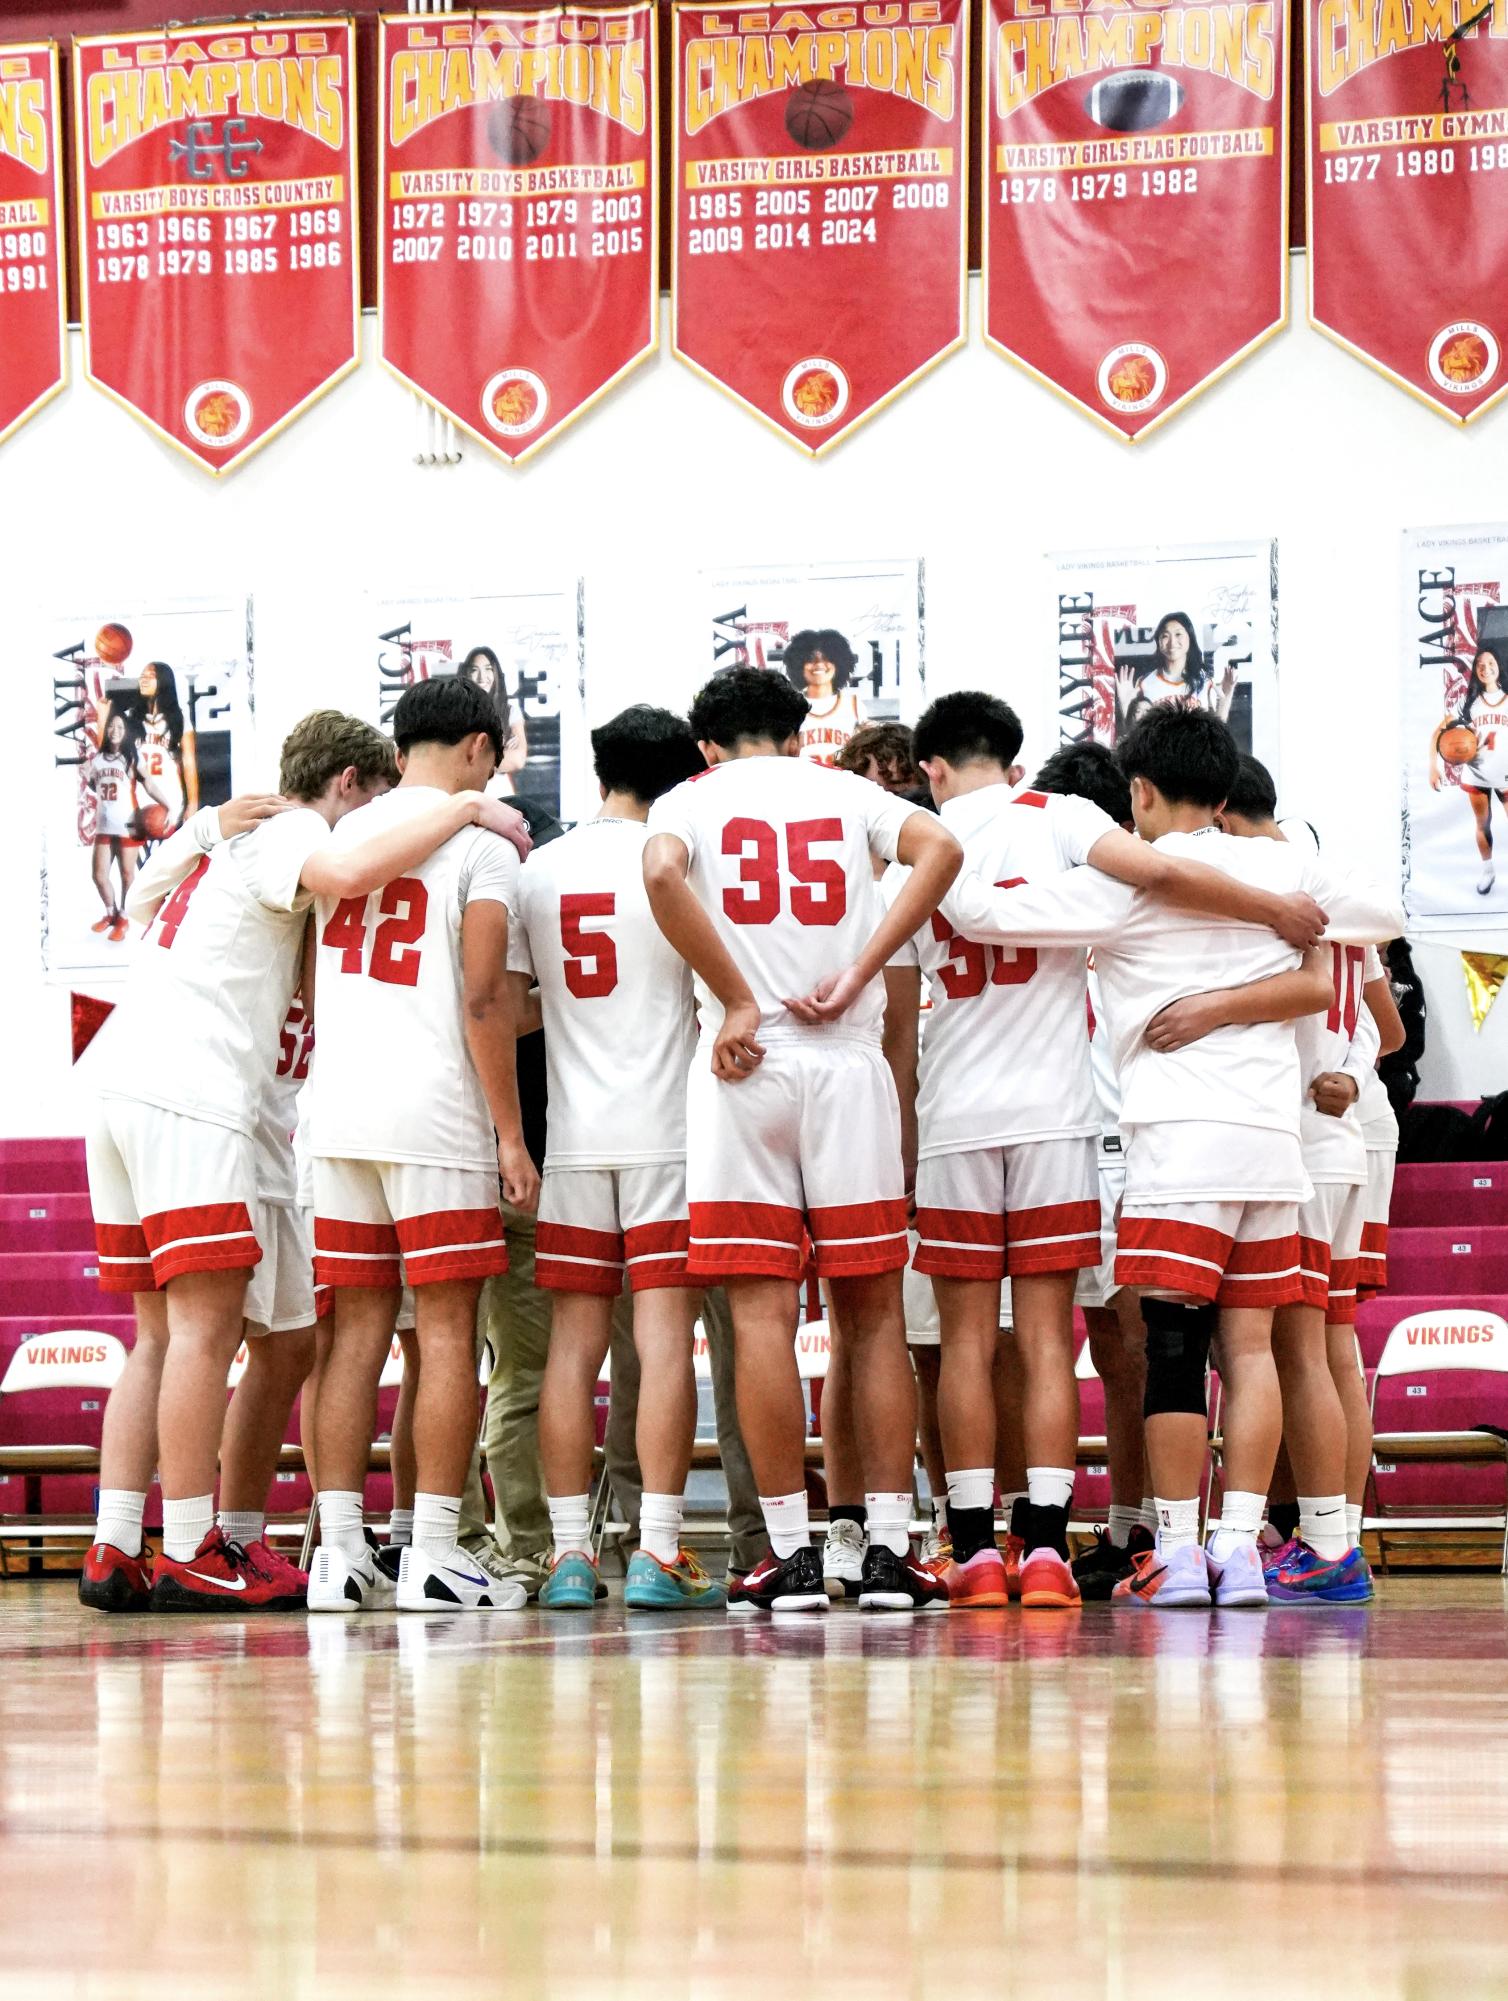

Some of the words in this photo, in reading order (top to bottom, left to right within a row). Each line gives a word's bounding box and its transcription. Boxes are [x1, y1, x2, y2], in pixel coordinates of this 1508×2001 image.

[408, 21, 636, 47] LEAGUE
[703, 3, 941, 34] LEAGUE
[103, 33, 328, 68] LEAGUE
[997, 2, 1275, 119] CHAMPIONS
[390, 40, 645, 147] CHAMPIONS
[685, 23, 954, 136] CHAMPIONS
[88, 54, 343, 168] CHAMPIONS
[1337, 117, 1434, 147] VARSITY
[1442, 112, 1508, 138] GYMN
[698, 161, 769, 184] VARSITY
[775, 158, 825, 181] GIRLS
[828, 151, 941, 179] BASKETBALL
[1006, 145, 1077, 169] VARSITY
[1082, 141, 1130, 165] GIRLS
[1133, 138, 1175, 161] FLAG
[1179, 131, 1264, 157] FOOTBALL
[1324, 153, 1381, 184] 1977
[1396, 148, 1454, 177] 1980
[102, 190, 165, 215] VARSITY
[169, 187, 209, 208] BOYS
[213, 184, 261, 206] CROSS
[264, 178, 334, 203] COUNTRY
[401, 171, 474, 194] VARSITY
[480, 168, 523, 192] BOYS
[527, 162, 634, 190] BASKETBALL
[1000, 177, 1057, 204] 1978
[1071, 173, 1127, 201] 1979
[1141, 168, 1198, 196] 1982
[393, 203, 444, 230] 1972
[457, 201, 513, 228] 1973
[526, 199, 578, 226] 1979
[591, 195, 642, 223] 2003
[688, 193, 742, 220] 1985
[755, 189, 810, 216] 2005
[824, 185, 878, 213] 2007
[892, 182, 949, 209] 2008
[96, 222, 149, 249] 1963
[157, 218, 211, 244] 1966
[224, 214, 277, 241] 1967
[289, 209, 341, 236] 1969
[392, 236, 443, 263] 2007
[457, 234, 512, 261] 2010
[525, 231, 577, 260] 2011
[591, 227, 642, 256] 2015
[688, 226, 742, 254] 2009
[755, 222, 810, 250] 2014
[821, 218, 877, 246] 2024
[97, 255, 149, 283] 1978
[157, 250, 211, 276] 1979
[224, 246, 278, 274] 1985
[289, 242, 341, 269] 1986
[1418, 566, 1455, 669] JACE
[53, 640, 86, 768] LAYLA
[101, 783, 117, 800] 32
[721, 816, 847, 926] 35
[141, 853, 212, 950] 4
[322, 877, 429, 987] 42
[560, 892, 619, 999] 5
[1406, 1324, 1495, 1346] VIKINGS
[26, 1345, 107, 1365] VIKINGS
